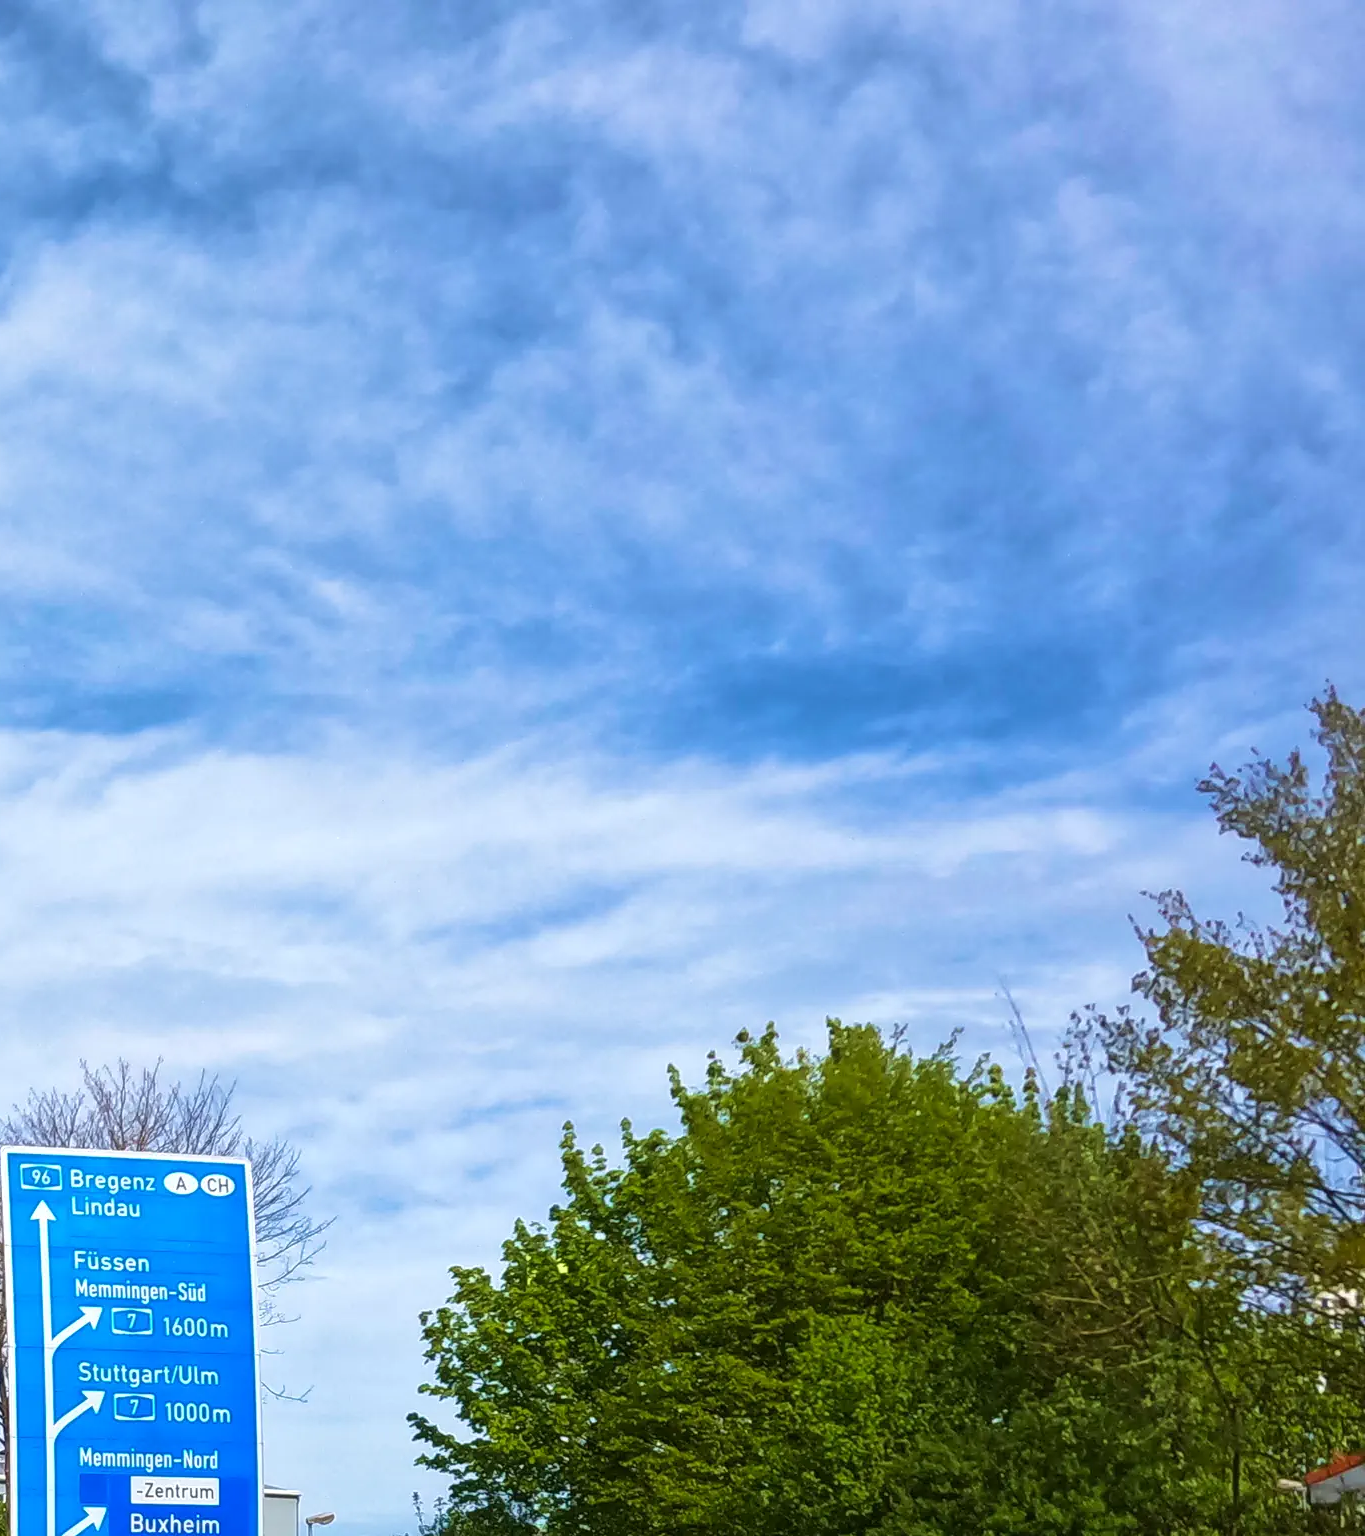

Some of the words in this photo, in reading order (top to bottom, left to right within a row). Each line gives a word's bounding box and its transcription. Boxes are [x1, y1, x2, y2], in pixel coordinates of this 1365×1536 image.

[31, 1169, 51, 1185] 96
[70, 1169, 156, 1194] Bregenz
[176, 1176, 187, 1191] A
[207, 1178, 229, 1193] CH
[71, 1197, 141, 1217] Lindau
[74, 1250, 150, 1272] Füssen
[75, 1278, 207, 1304] Memmingen-Süd
[127, 1313, 137, 1329] 7
[78, 1362, 219, 1388] Stuttgart/Ulm
[130, 1399, 139, 1415] 7
[79, 1447, 219, 1473] Memmingen-Nord
[136, 1482, 215, 1500] -Zentrum
[130, 1513, 220, 1534] Buxheim
